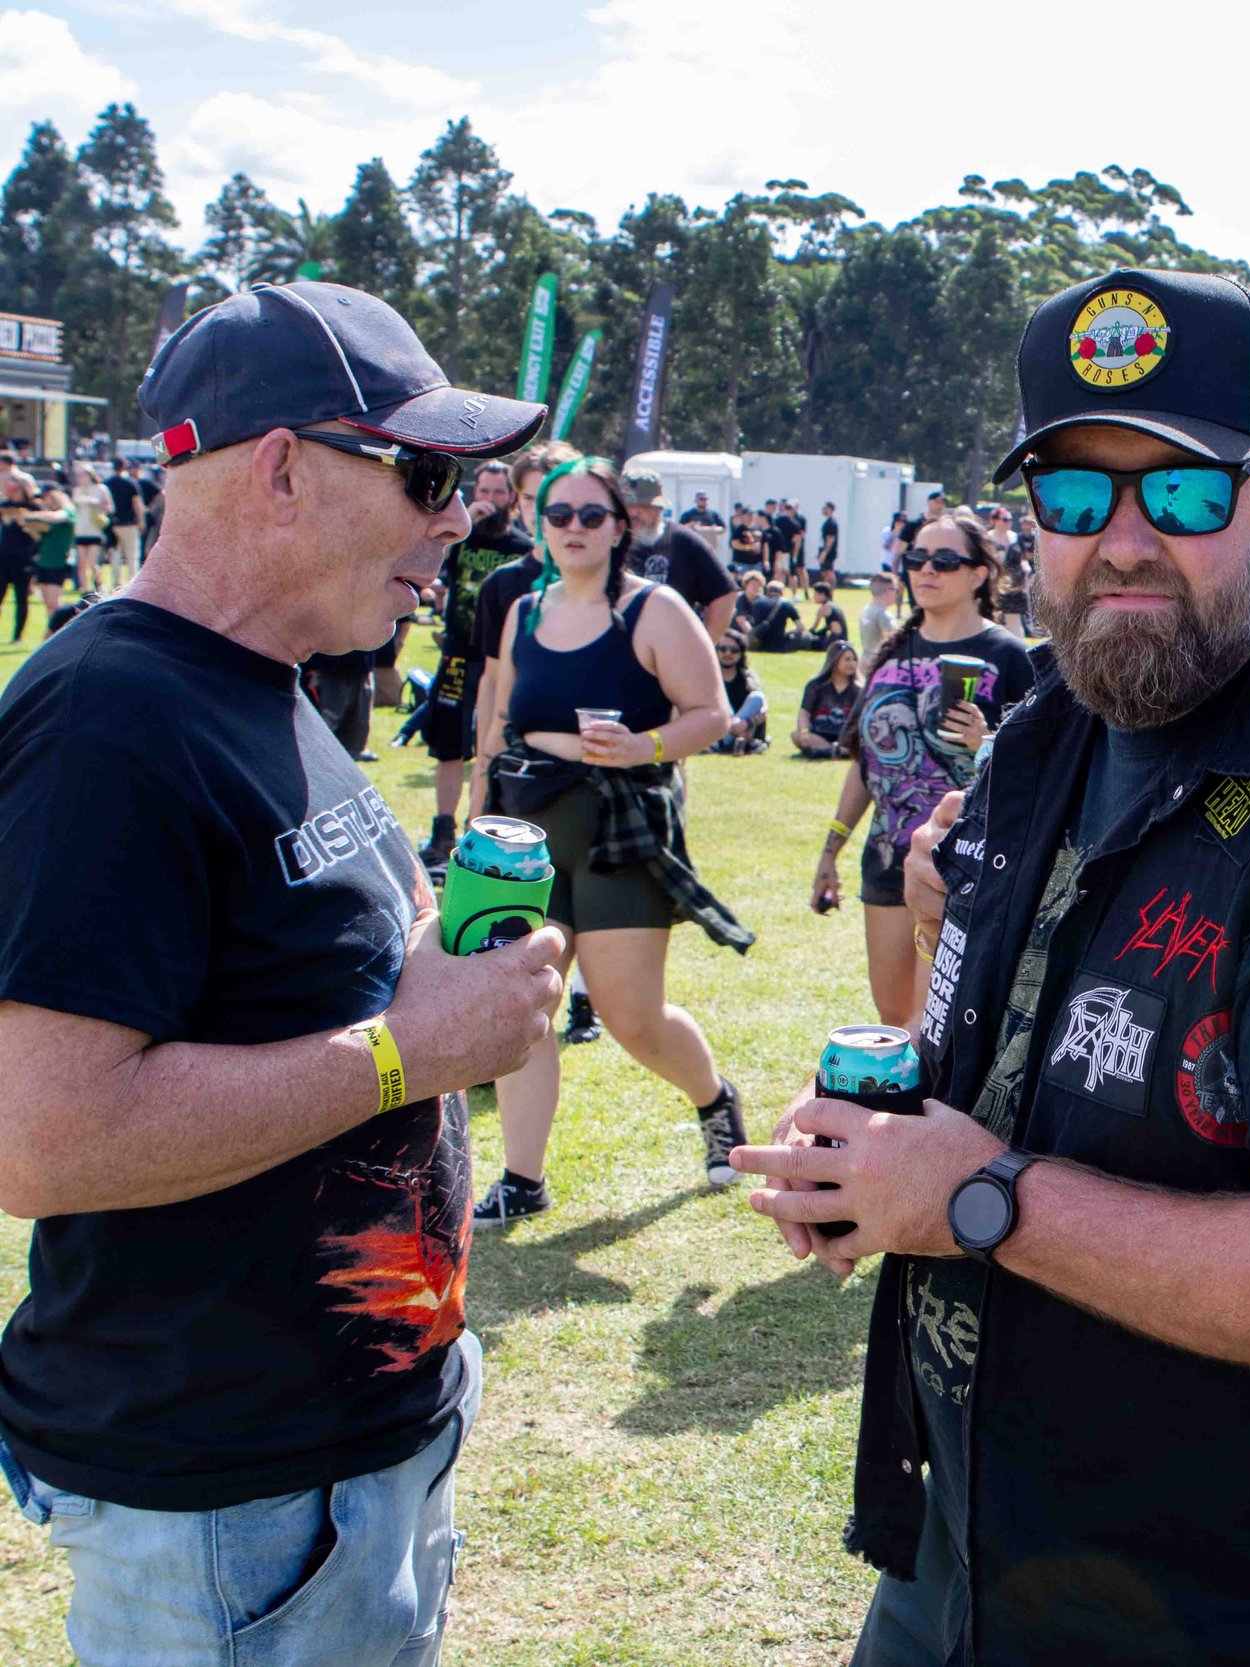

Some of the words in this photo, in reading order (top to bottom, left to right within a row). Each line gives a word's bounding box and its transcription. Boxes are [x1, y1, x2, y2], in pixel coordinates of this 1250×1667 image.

[634, 314, 666, 433] ACCESSIBLE
[1082, 362, 1145, 384] ROSES
[1113, 887, 1232, 995] SLAYER
[1051, 987, 1155, 1092] DEATH
[1182, 1059, 1196, 1072] 1987
